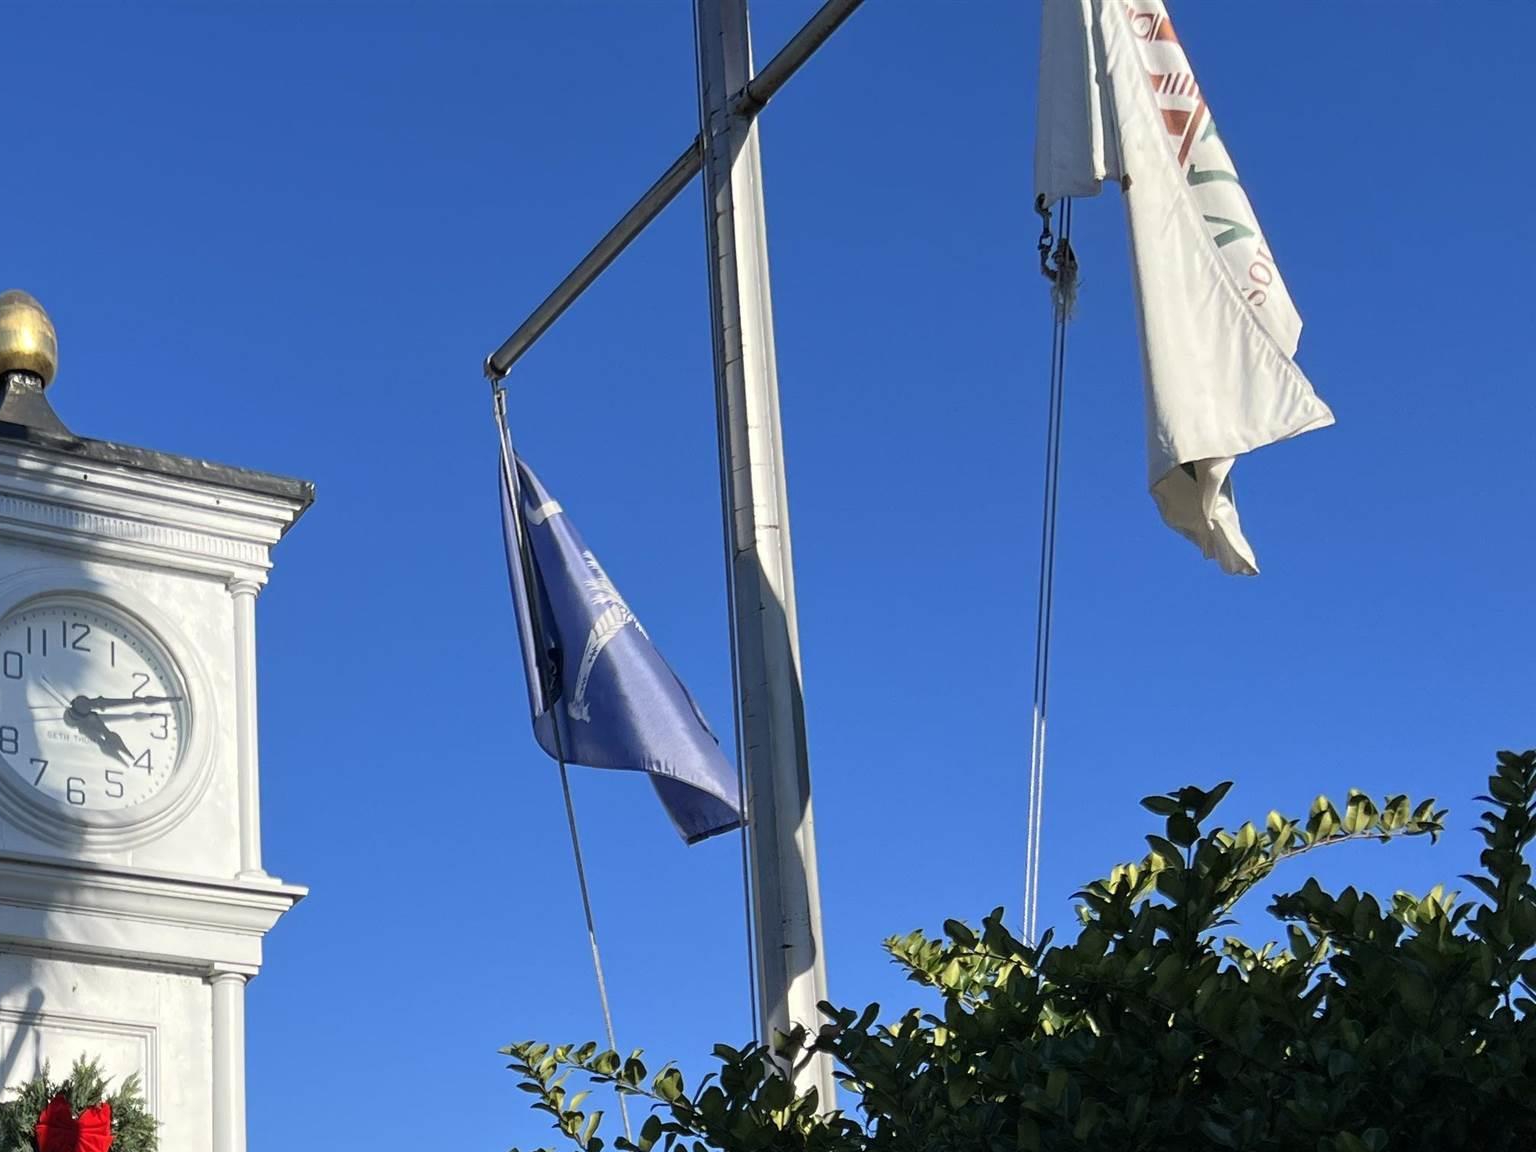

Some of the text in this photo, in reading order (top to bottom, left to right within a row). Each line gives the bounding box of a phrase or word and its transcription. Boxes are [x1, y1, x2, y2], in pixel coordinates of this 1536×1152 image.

[27, 626, 47, 657] 11
[62, 620, 91, 653] 12
[110, 640, 116, 668] 1
[131, 672, 151, 700] 2
[149, 712, 169, 741] 3
[29, 757, 49, 787] 7
[132, 748, 154, 777] 4
[66, 776, 86, 806] 6
[104, 768, 124, 799] 5
